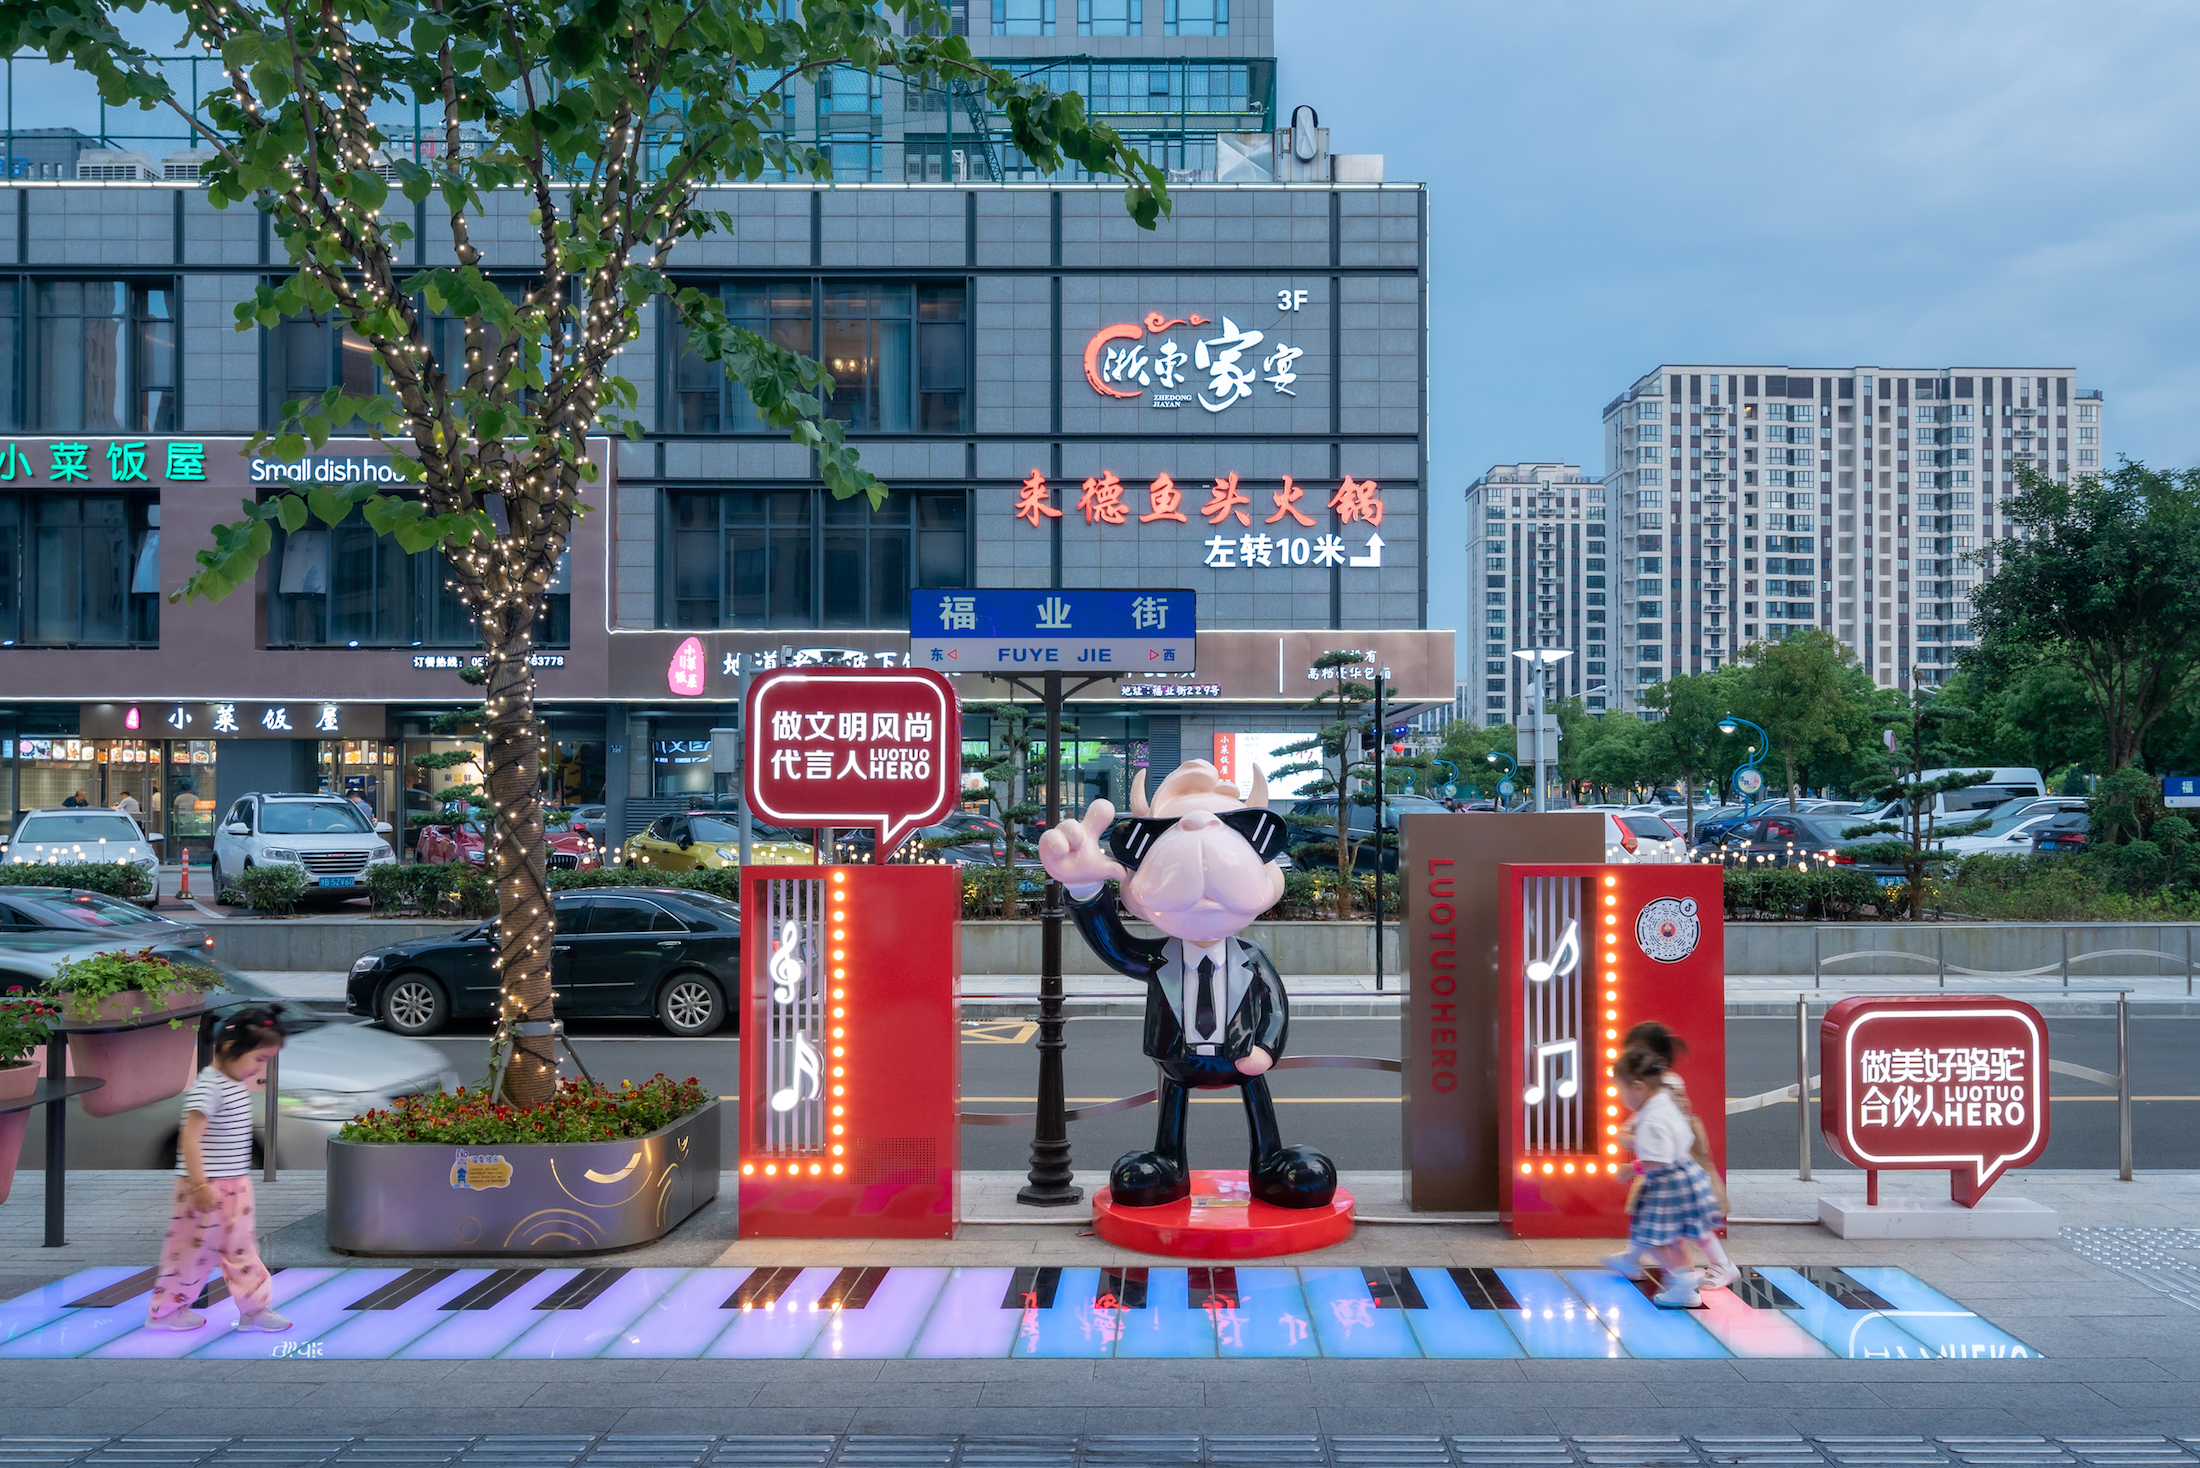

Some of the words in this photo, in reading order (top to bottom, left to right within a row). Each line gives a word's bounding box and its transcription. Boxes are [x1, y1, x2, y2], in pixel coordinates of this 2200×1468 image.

[1277, 289, 1308, 311] 3F
[0, 442, 206, 482] 小菜饭屋
[314, 458, 361, 482] dish
[1203, 533, 1346, 568] 左转10米
[938, 596, 1170, 631] 福业街
[930, 647, 944, 662] 东
[998, 648, 1059, 662] FUYE
[1077, 648, 1112, 662] JIE
[1162, 648, 1176, 662] 西
[168, 704, 339, 733] 小菜饭屋
[771, 710, 933, 742] 做文明风尚
[770, 749, 868, 780] 代言人
[869, 748, 930, 761] LUOTUO
[869, 761, 931, 780] HERO
[1428, 858, 1459, 1094] LUOTUOHERO
[1860, 1047, 2026, 1083] 做美好骆驼
[1860, 1085, 1943, 1128] 合伙人
[1944, 1085, 2025, 1102] LUOTUO
[1944, 1102, 2026, 1127] HERO
